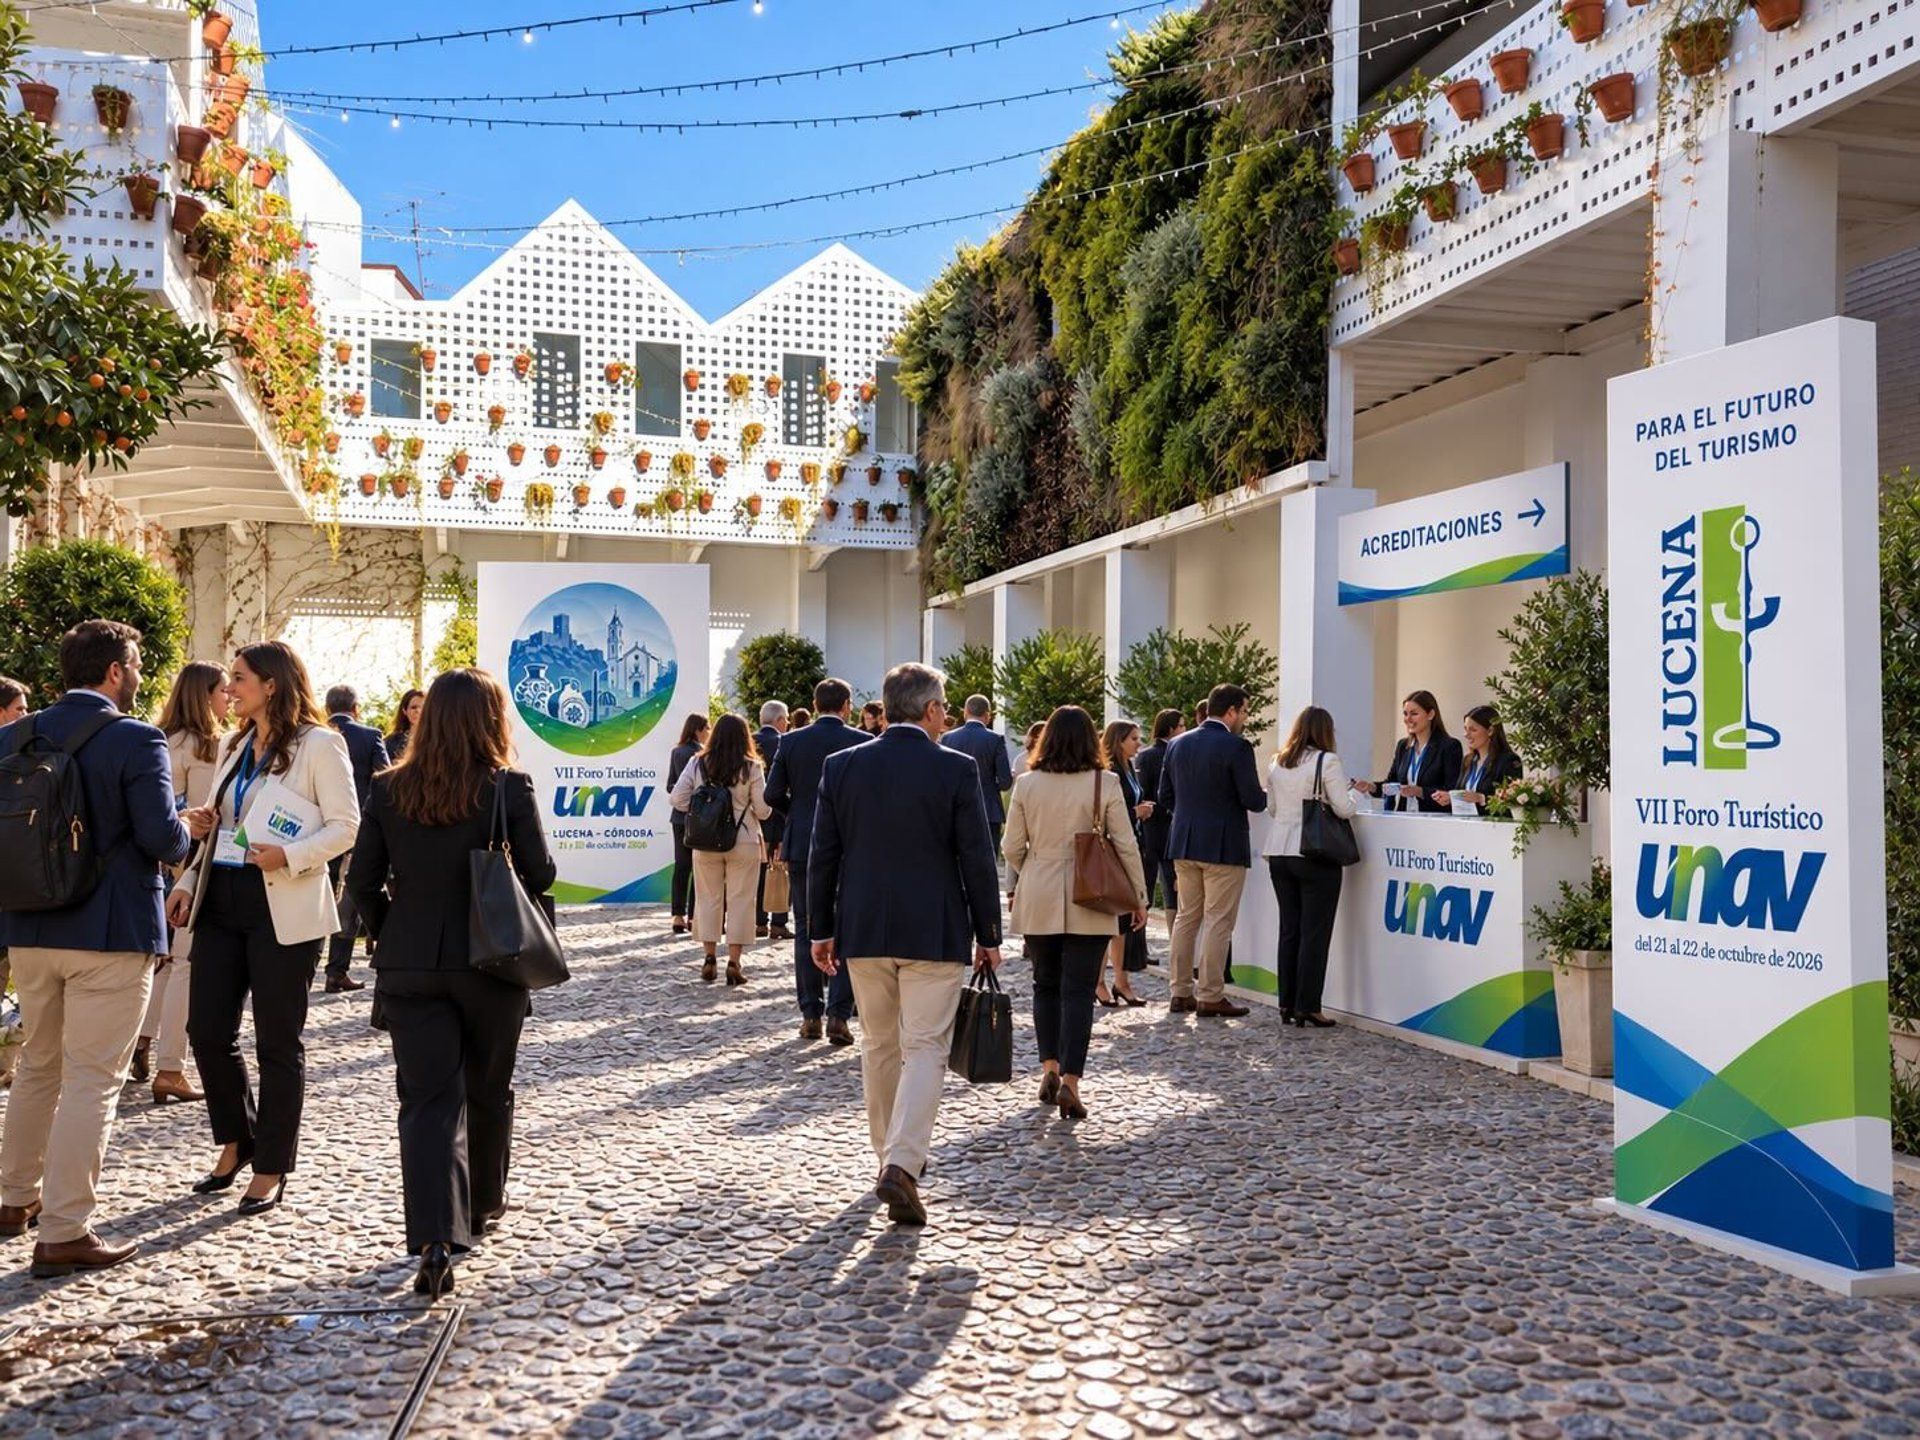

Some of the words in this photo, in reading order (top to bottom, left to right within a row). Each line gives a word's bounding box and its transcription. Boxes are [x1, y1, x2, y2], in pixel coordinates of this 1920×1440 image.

[1636, 414, 1686, 442] PARA
[1694, 406, 1717, 430] EL
[1725, 383, 1815, 419] FUTURO
[1655, 447, 1691, 472] DEL
[1699, 424, 1797, 462] TURISMO
[1361, 511, 1502, 557] ACREDITACIONES
[1662, 515, 1698, 767] LUCENA
[554, 767, 574, 779] VII
[577, 767, 604, 779] Foro
[604, 827, 653, 838] CÓRDOBA
[1636, 798, 1668, 825] VII
[1673, 800, 1719, 826] Foro
[1724, 801, 1823, 831] Turístico
[1385, 848, 1404, 868] VII
[1407, 850, 1435, 871] Foro
[1437, 852, 1494, 876] Turístico
[1635, 935, 1651, 952] del
[1654, 937, 1667, 953] 21
[1670, 939, 1680, 955] al
[1683, 941, 1698, 957] 22
[1701, 942, 1716, 959] de
[1718, 945, 1766, 965] octubre
[1768, 949, 1784, 967] de
[1787, 950, 1823, 971] 2026
